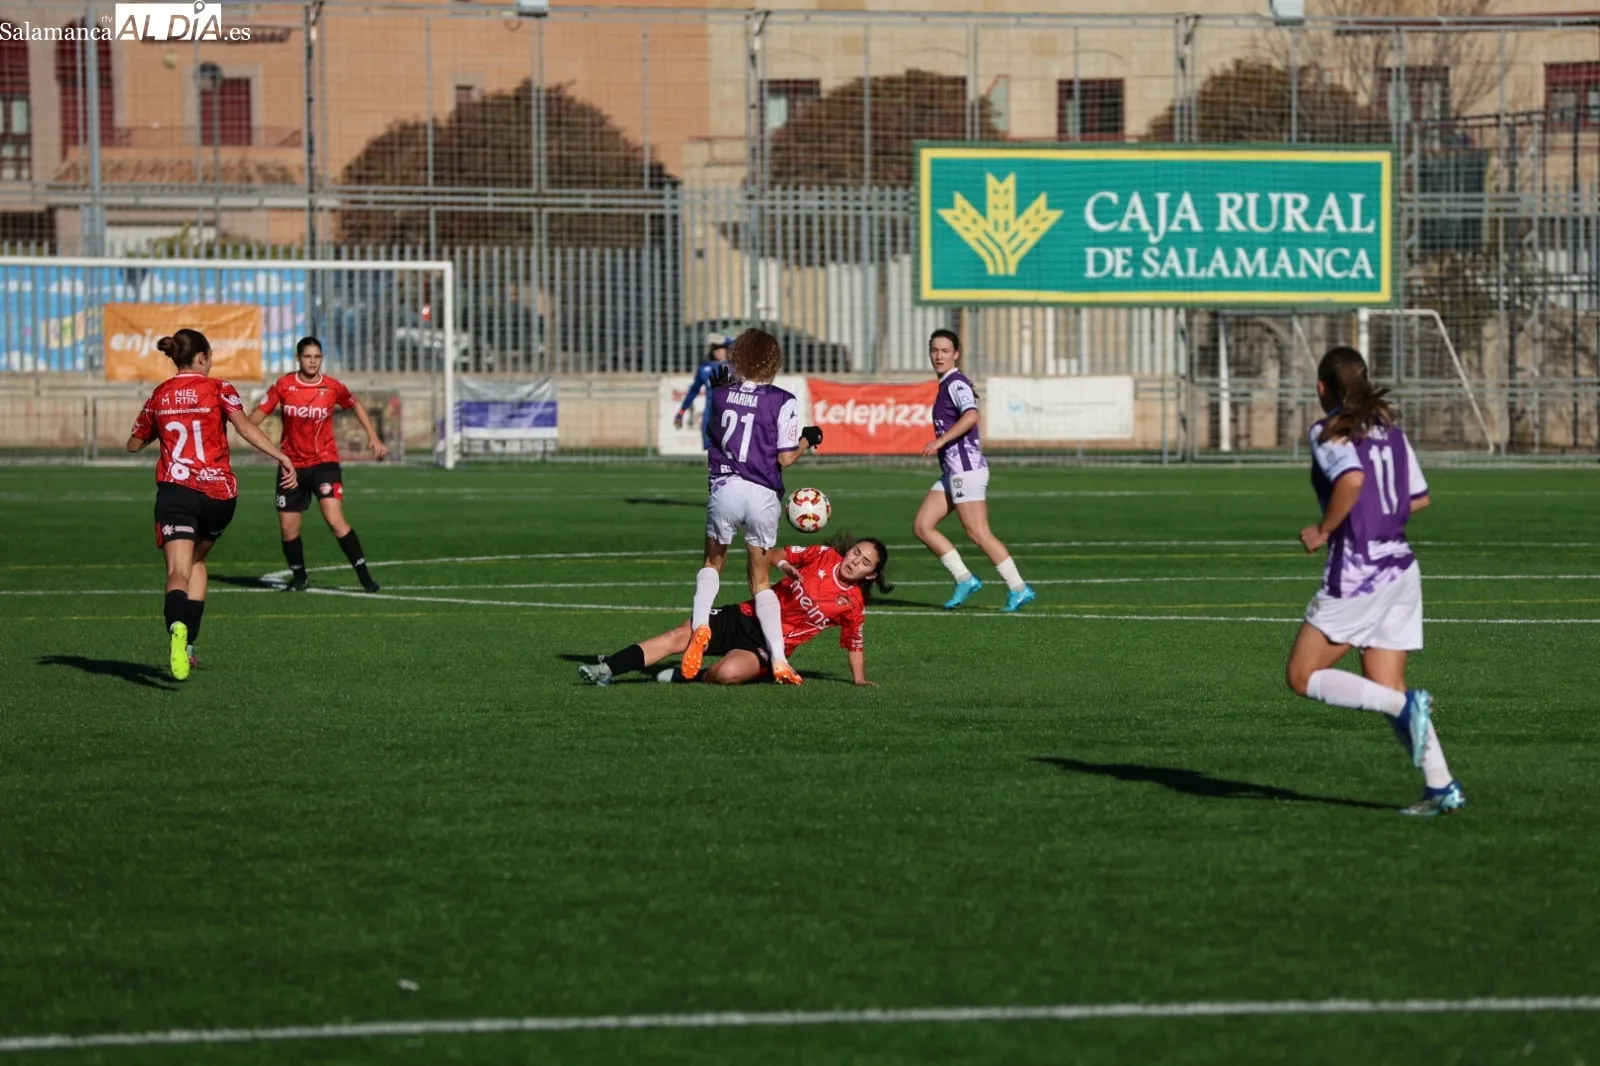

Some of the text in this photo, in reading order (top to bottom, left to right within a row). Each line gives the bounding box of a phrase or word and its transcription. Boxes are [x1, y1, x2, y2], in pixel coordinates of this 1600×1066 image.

[1084, 191, 1376, 243] CAJA RURAL
[1084, 247, 1375, 279] DE SALAMANCA
[283, 405, 328, 418] meins
[726, 391, 758, 408] MARINA
[165, 420, 206, 465] 21
[721, 409, 755, 463] 21
[1368, 444, 1399, 515] 11
[790, 580, 830, 630] meins
